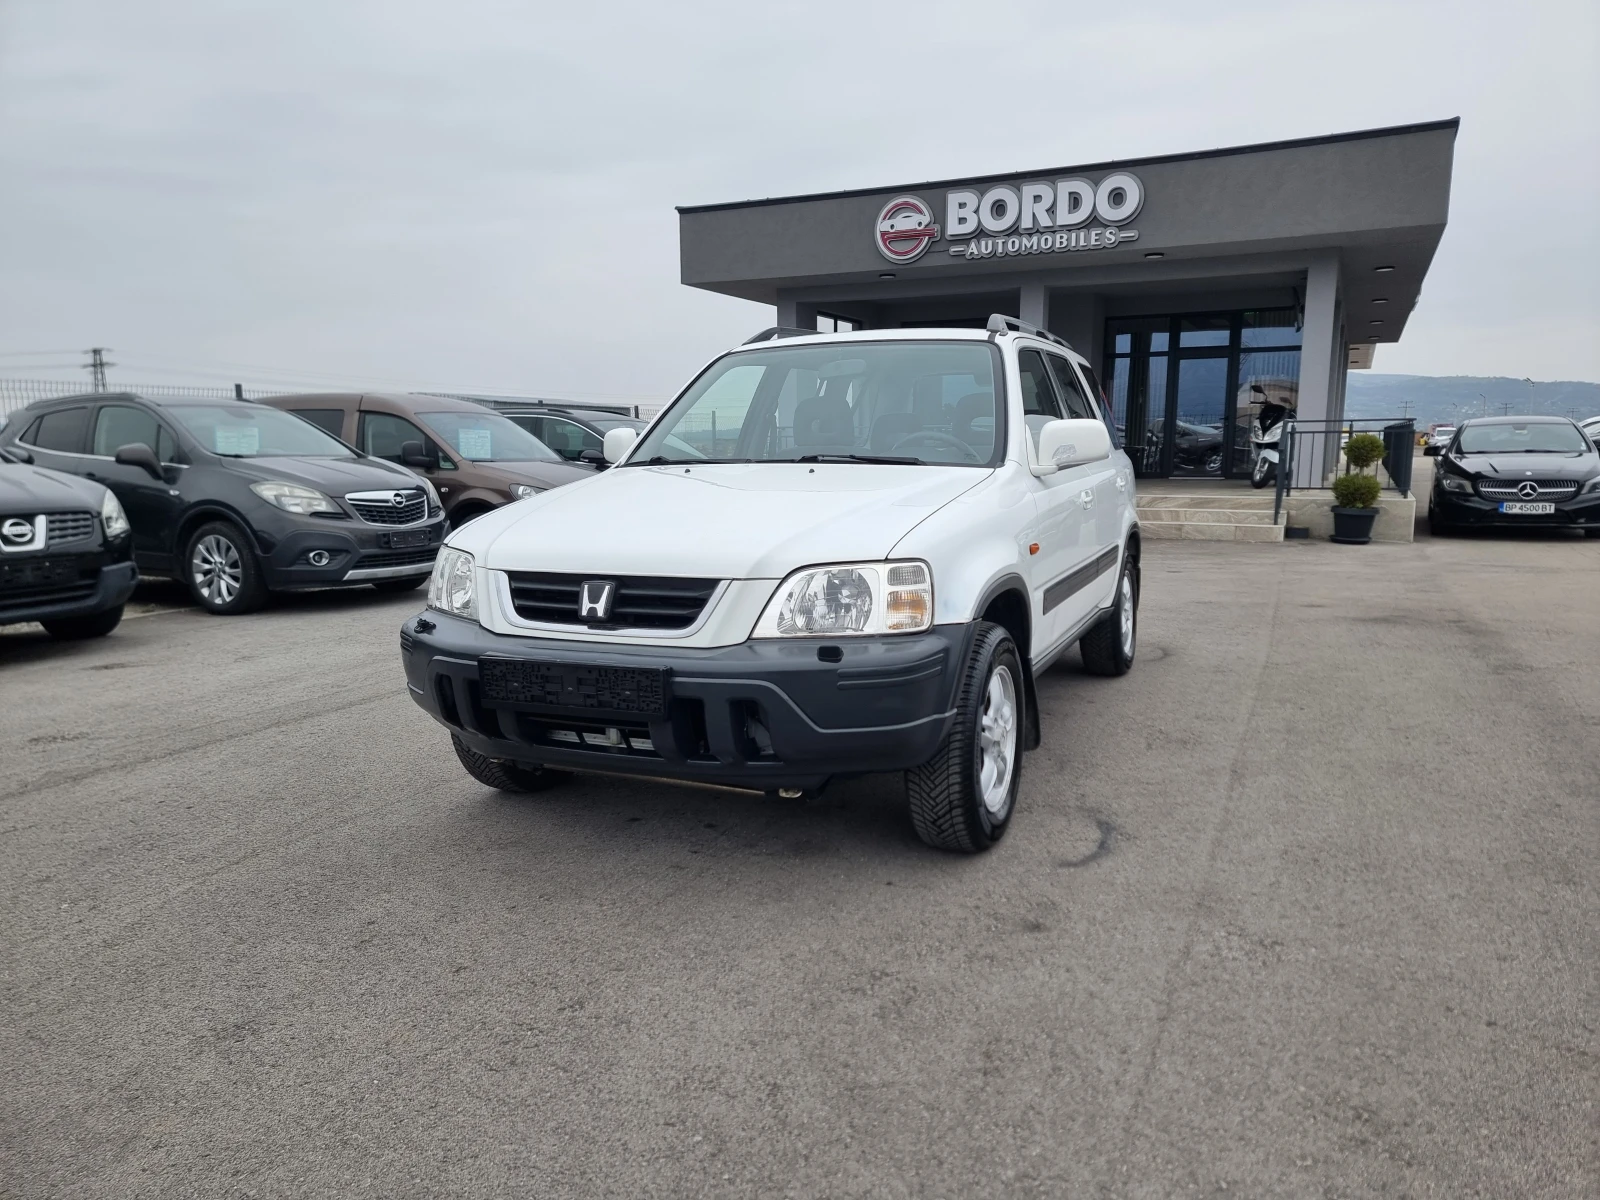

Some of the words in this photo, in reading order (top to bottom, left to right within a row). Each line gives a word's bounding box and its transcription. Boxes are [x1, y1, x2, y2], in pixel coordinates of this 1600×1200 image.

[947, 175, 1140, 236] BORDO
[967, 229, 1116, 255] AUTOMOBILES
[1518, 504, 1540, 512] 4500
